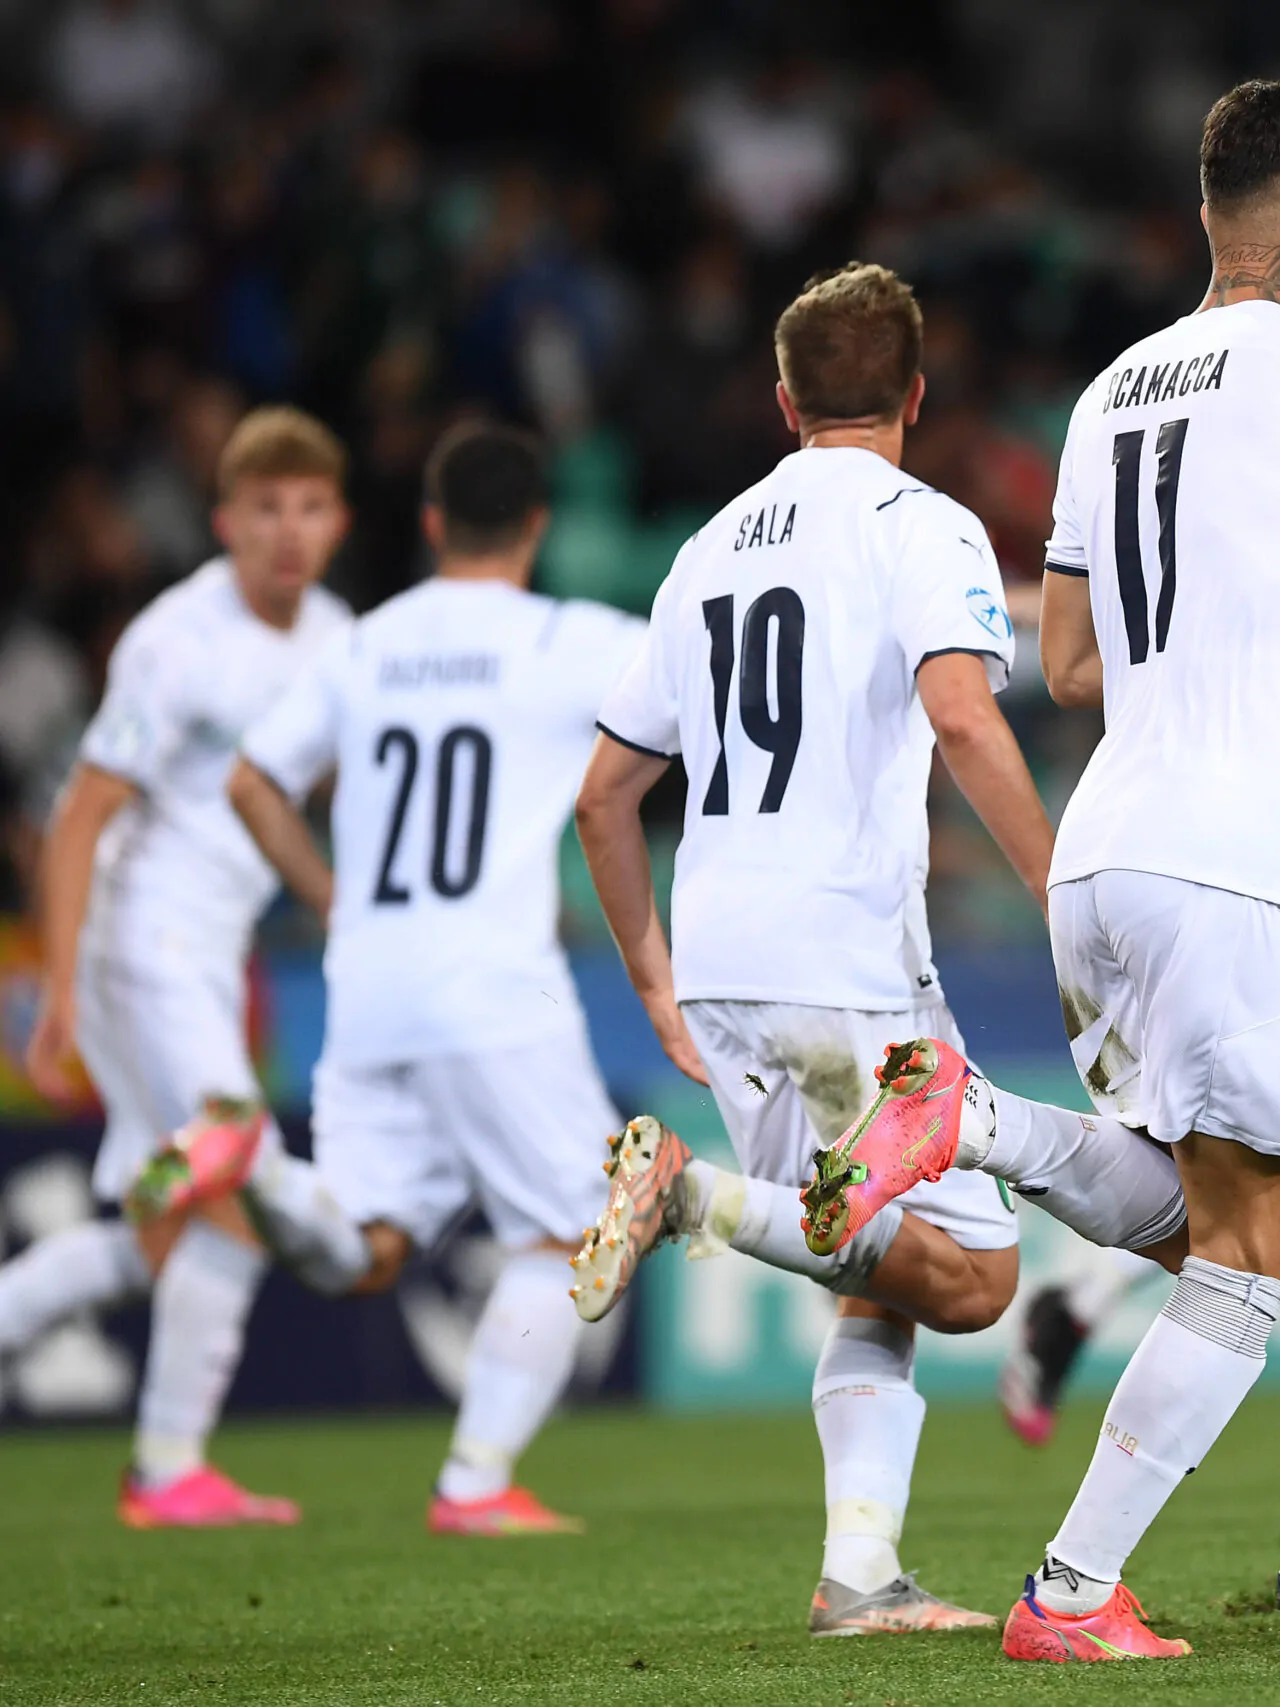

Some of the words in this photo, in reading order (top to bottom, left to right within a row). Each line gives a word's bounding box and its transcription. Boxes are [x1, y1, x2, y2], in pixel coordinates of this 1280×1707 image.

[1103, 349, 1230, 415] SCAMACCA
[734, 503, 798, 552] SALA
[1112, 418, 1189, 666] 11
[702, 587, 805, 816] 19
[373, 725, 493, 904] 20
